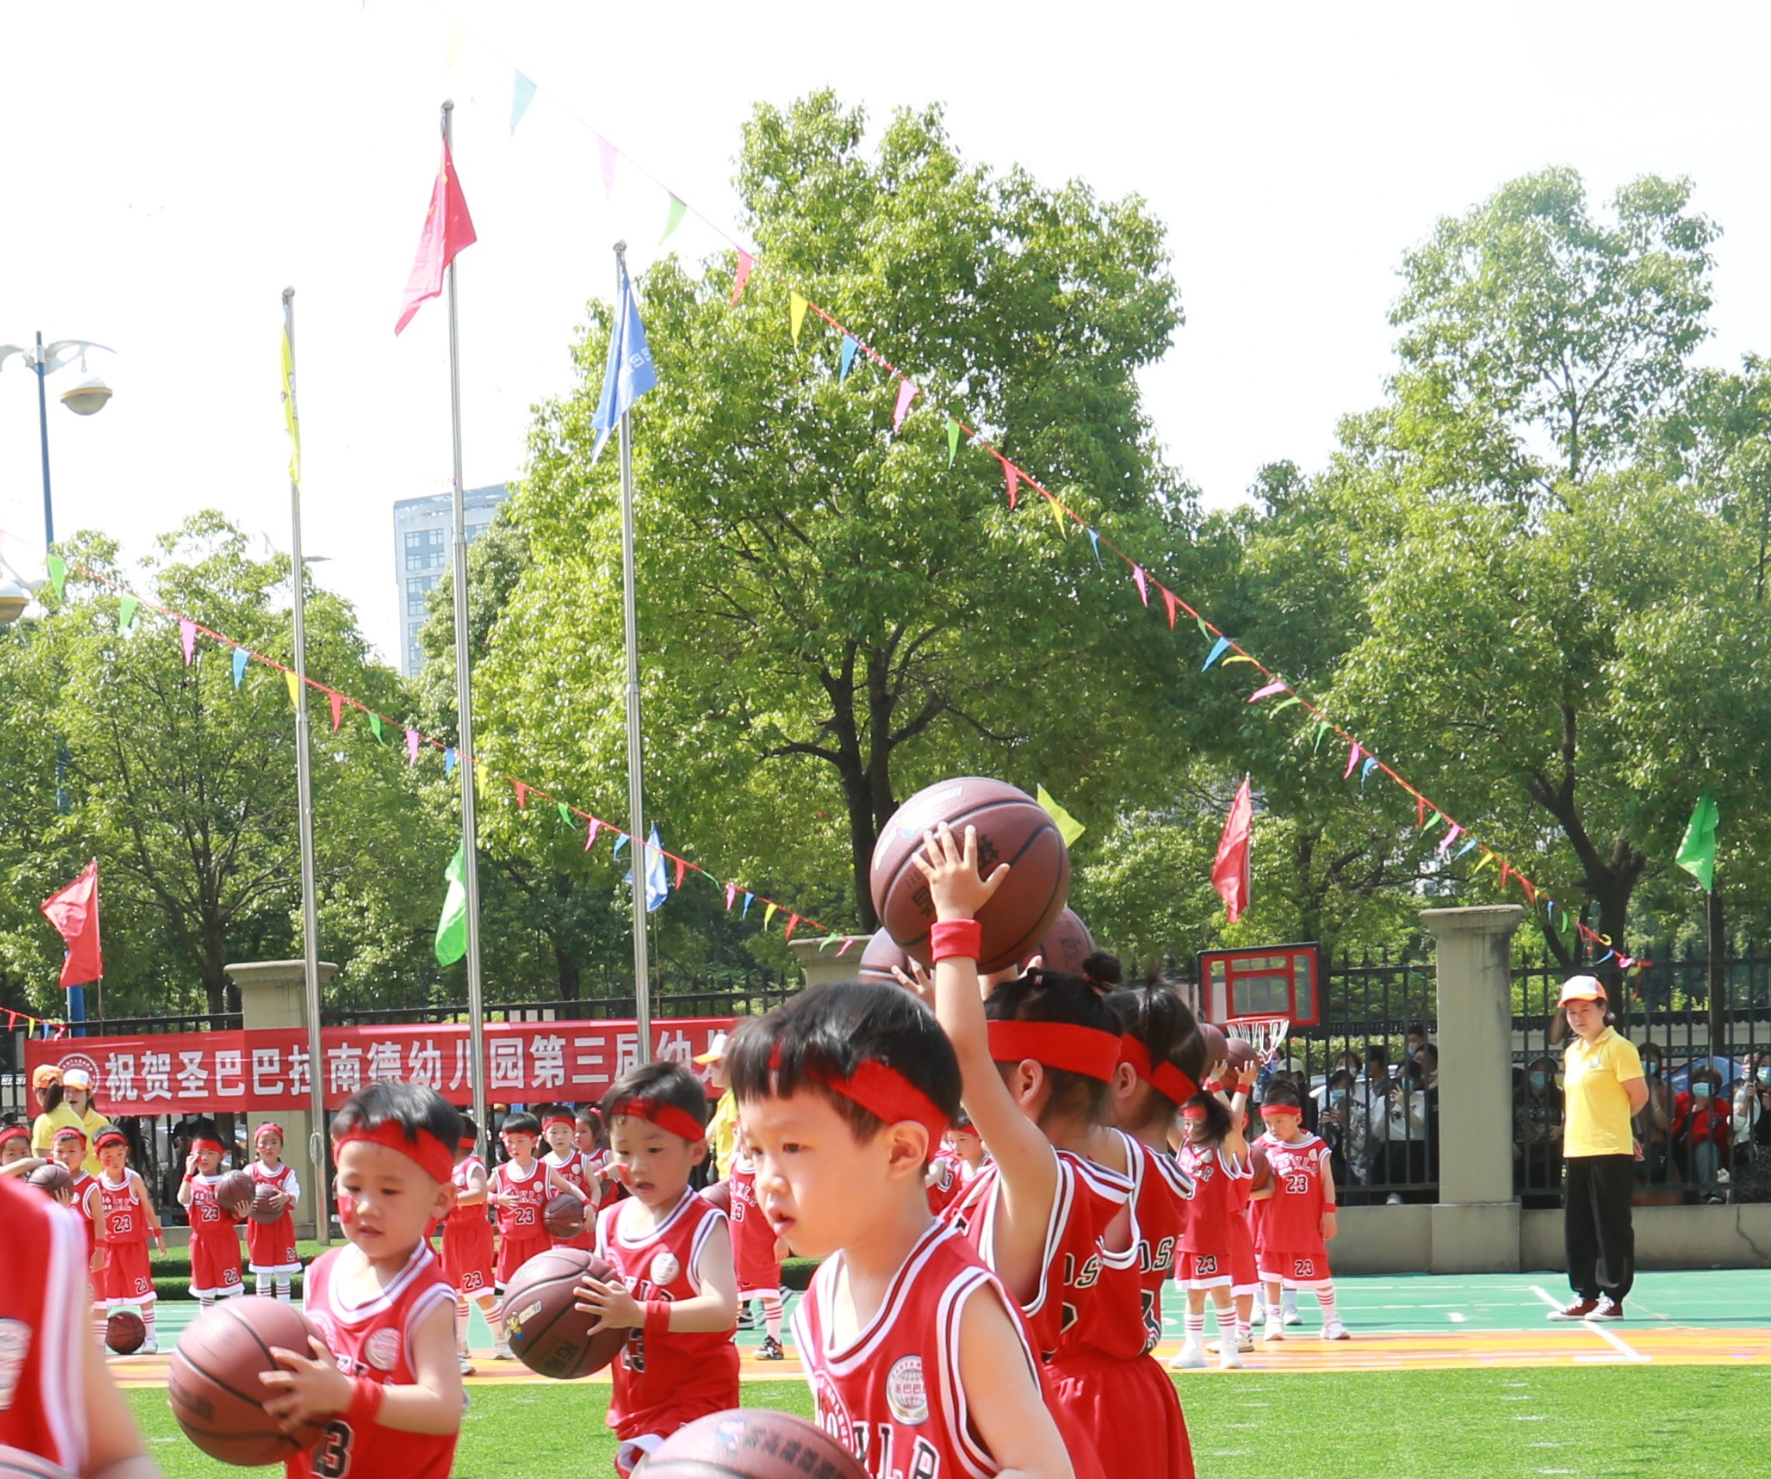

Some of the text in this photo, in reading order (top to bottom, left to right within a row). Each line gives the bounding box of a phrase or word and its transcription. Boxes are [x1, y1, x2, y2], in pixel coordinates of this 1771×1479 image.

[1286, 1174, 1308, 1194] 23
[202, 1205, 220, 1222] 23
[514, 1207, 535, 1226] 23
[112, 1215, 132, 1234] 23
[1196, 1255, 1218, 1275] 23
[1294, 1258, 1315, 1278] 23
[463, 1271, 484, 1291] 23
